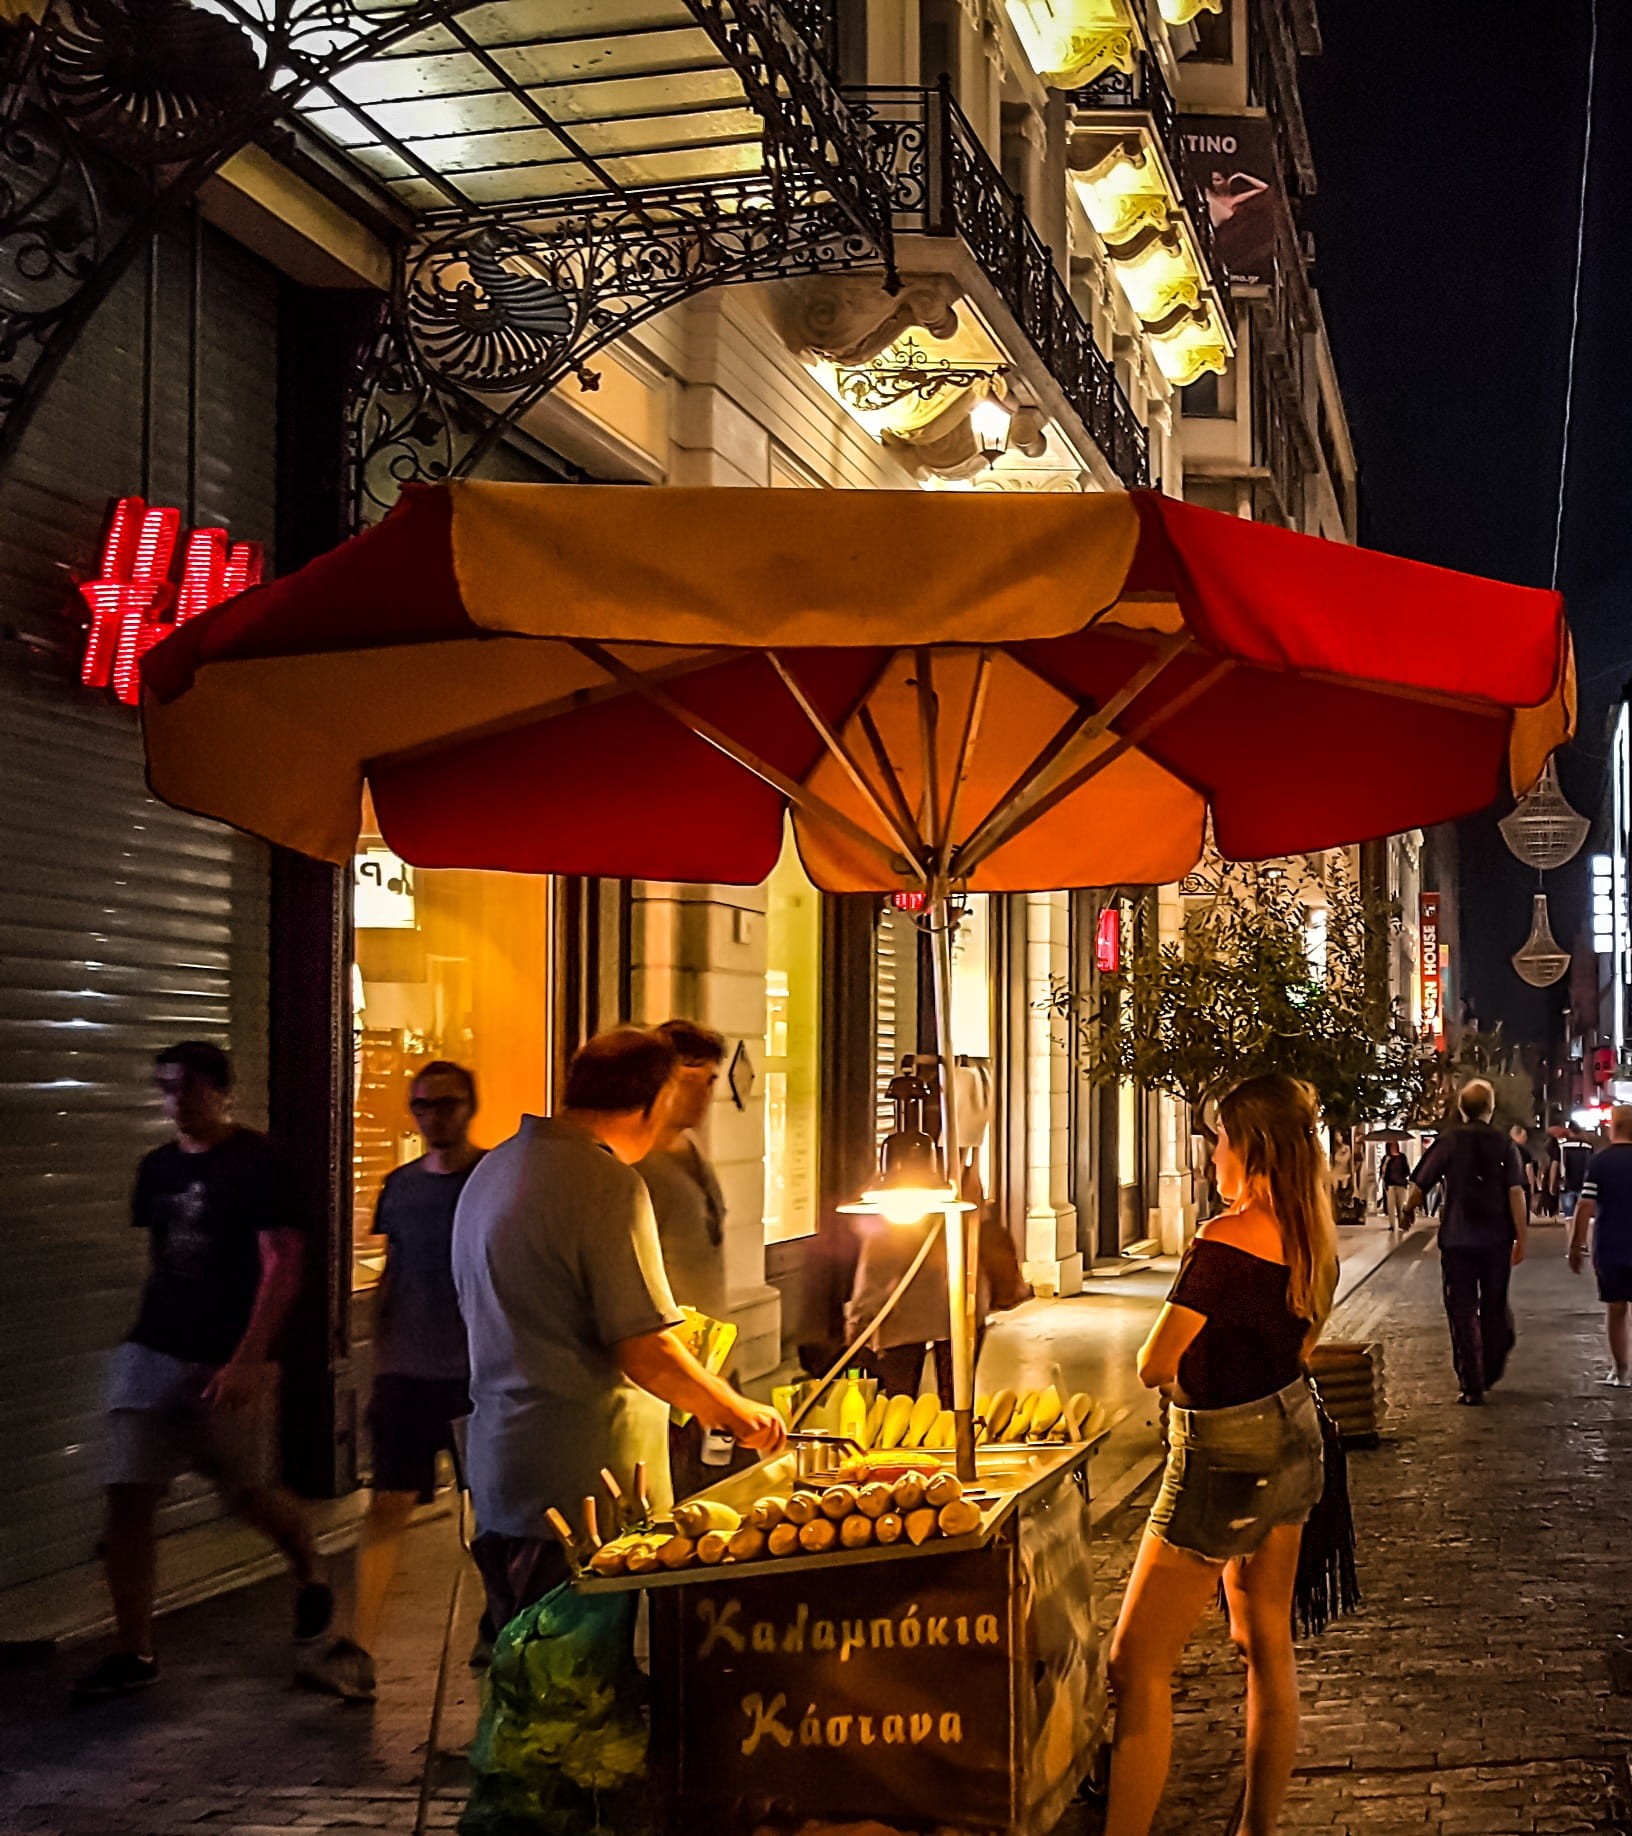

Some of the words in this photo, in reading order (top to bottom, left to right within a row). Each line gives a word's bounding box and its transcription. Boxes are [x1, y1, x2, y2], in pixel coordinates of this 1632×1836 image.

[1423, 925, 1437, 976] HOUSE
[697, 1599, 1000, 1662] Καλαμπόκια
[741, 1691, 963, 1755] Κάστανα
